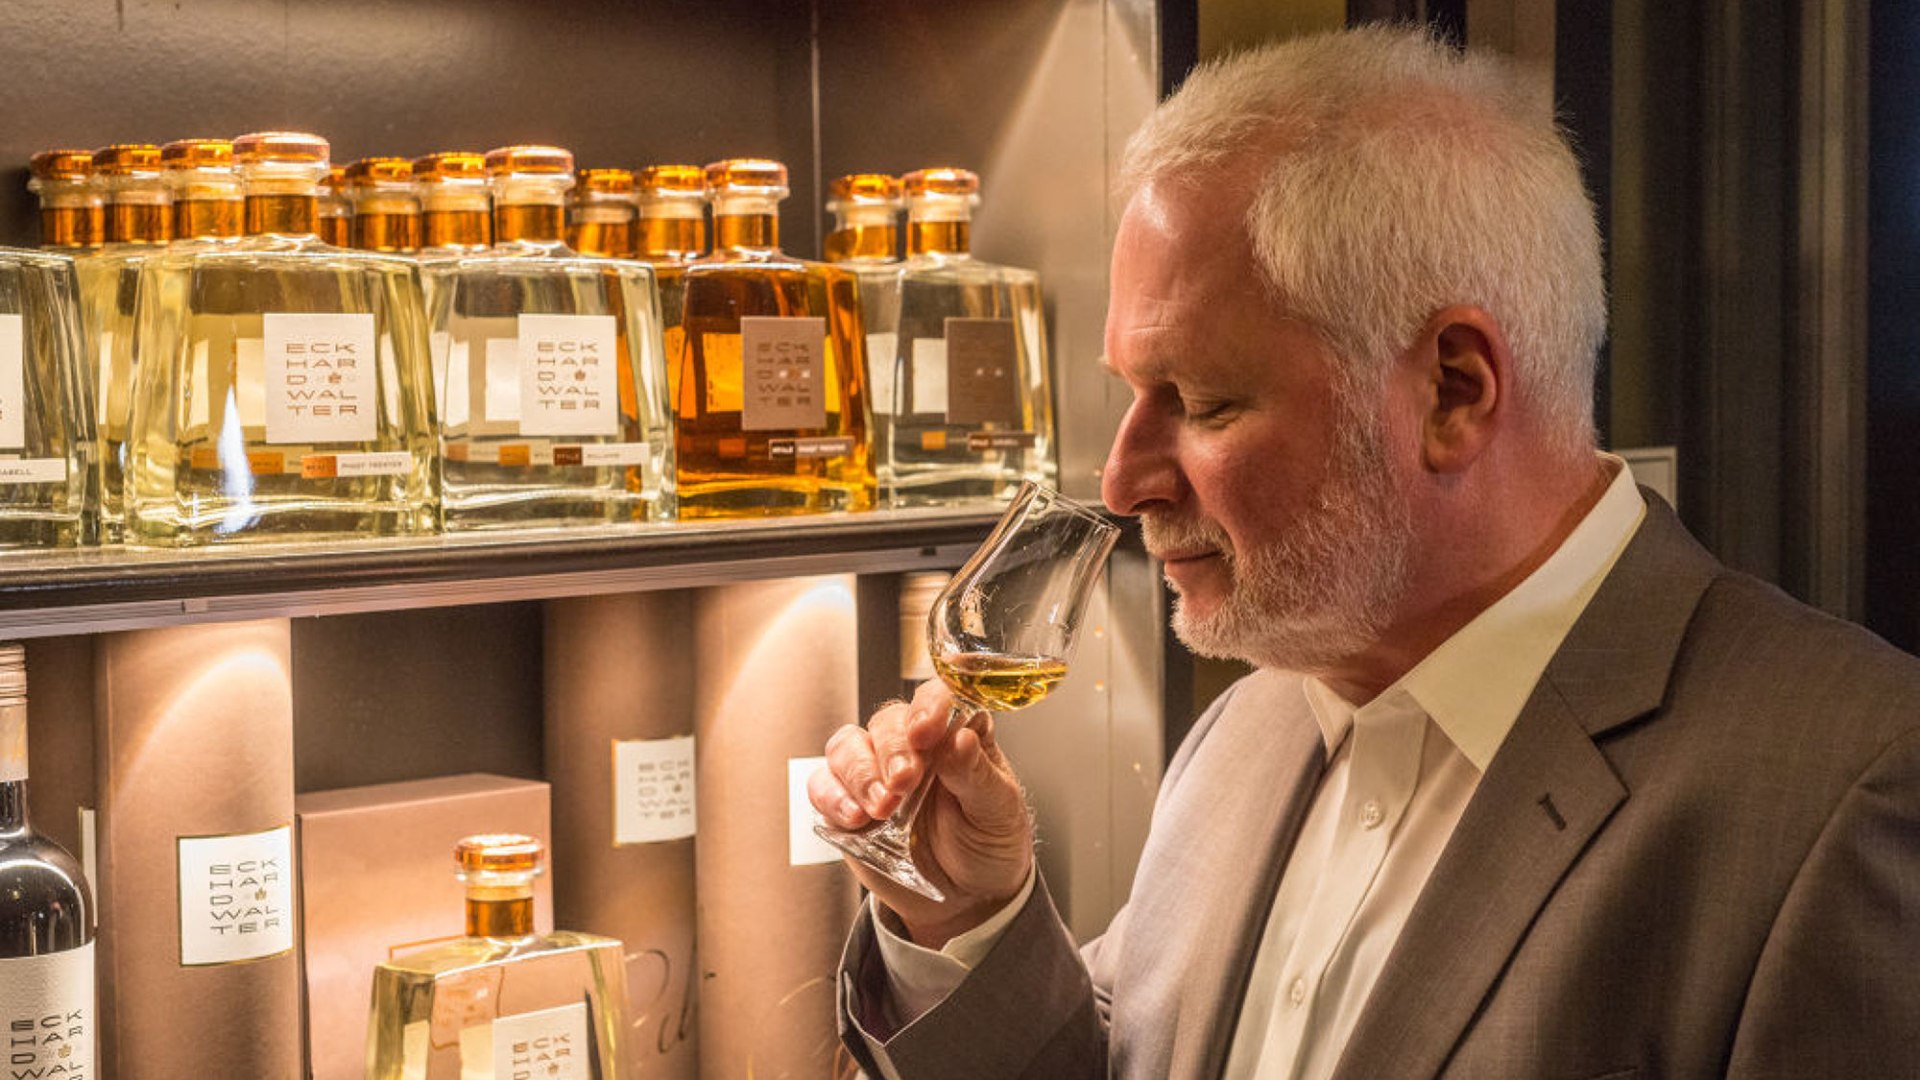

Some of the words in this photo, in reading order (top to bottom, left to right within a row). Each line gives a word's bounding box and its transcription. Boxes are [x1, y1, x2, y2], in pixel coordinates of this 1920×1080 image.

[286, 343, 356, 354] ECK
[537, 341, 598, 352] ECK
[757, 342, 810, 353] ECK
[286, 358, 357, 369] HAR
[537, 356, 599, 366] HAR
[757, 356, 810, 365] HAR
[286, 374, 307, 385] D
[537, 371, 555, 382] D
[538, 385, 600, 395] WAL
[758, 383, 810, 393] WAL
[287, 389, 357, 400] WAL
[538, 399, 600, 410] TER
[287, 405, 358, 416] TER
[209, 857, 278, 875] ECK
[209, 872, 278, 890] HAR
[209, 894, 233, 906] D
[210, 905, 279, 921] WAL
[210, 917, 280, 935] TER
[11, 1008, 83, 1032] ECK
[11, 1025, 83, 1048] HAR
[513, 1032, 571, 1053] ECK
[11, 1052, 36, 1065] D
[513, 1048, 571, 1067] HAR
[11, 1061, 83, 1080] WAL
